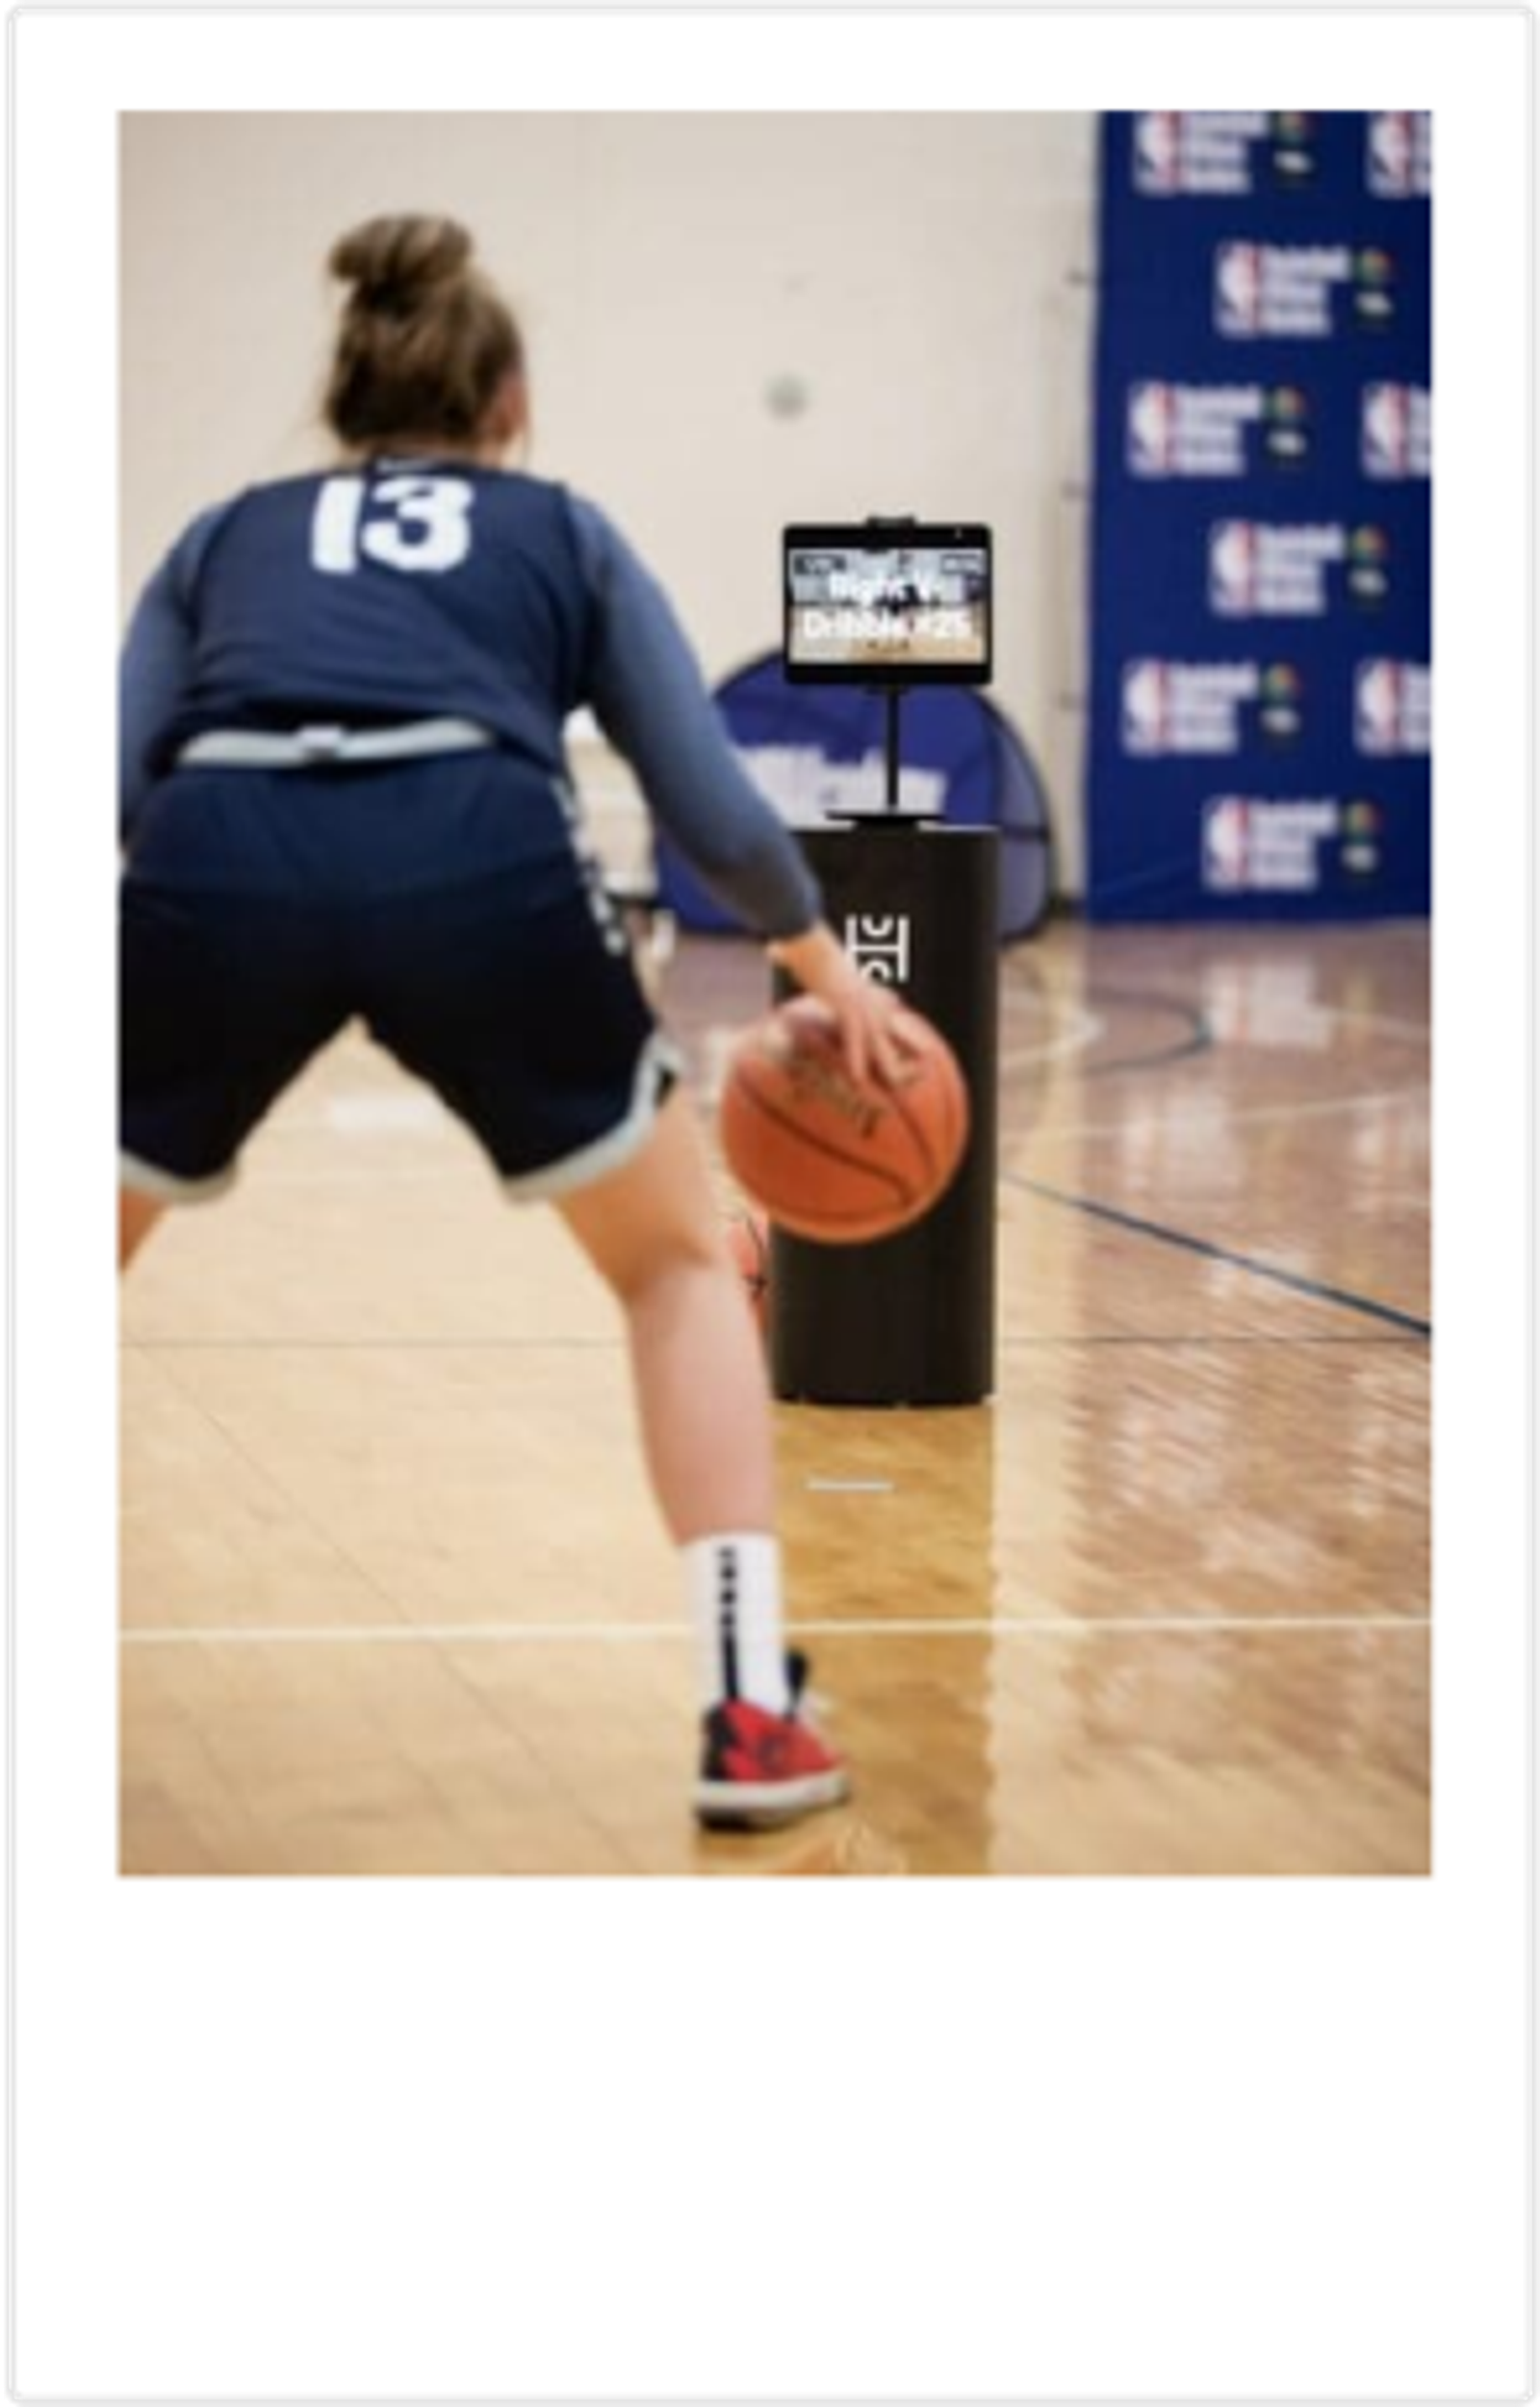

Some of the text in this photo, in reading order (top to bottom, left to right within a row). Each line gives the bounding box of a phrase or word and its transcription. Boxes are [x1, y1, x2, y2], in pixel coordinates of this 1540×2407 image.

[312, 476, 474, 573] 13
[830, 570, 904, 607] Right
[804, 608, 907, 638] Dribble
